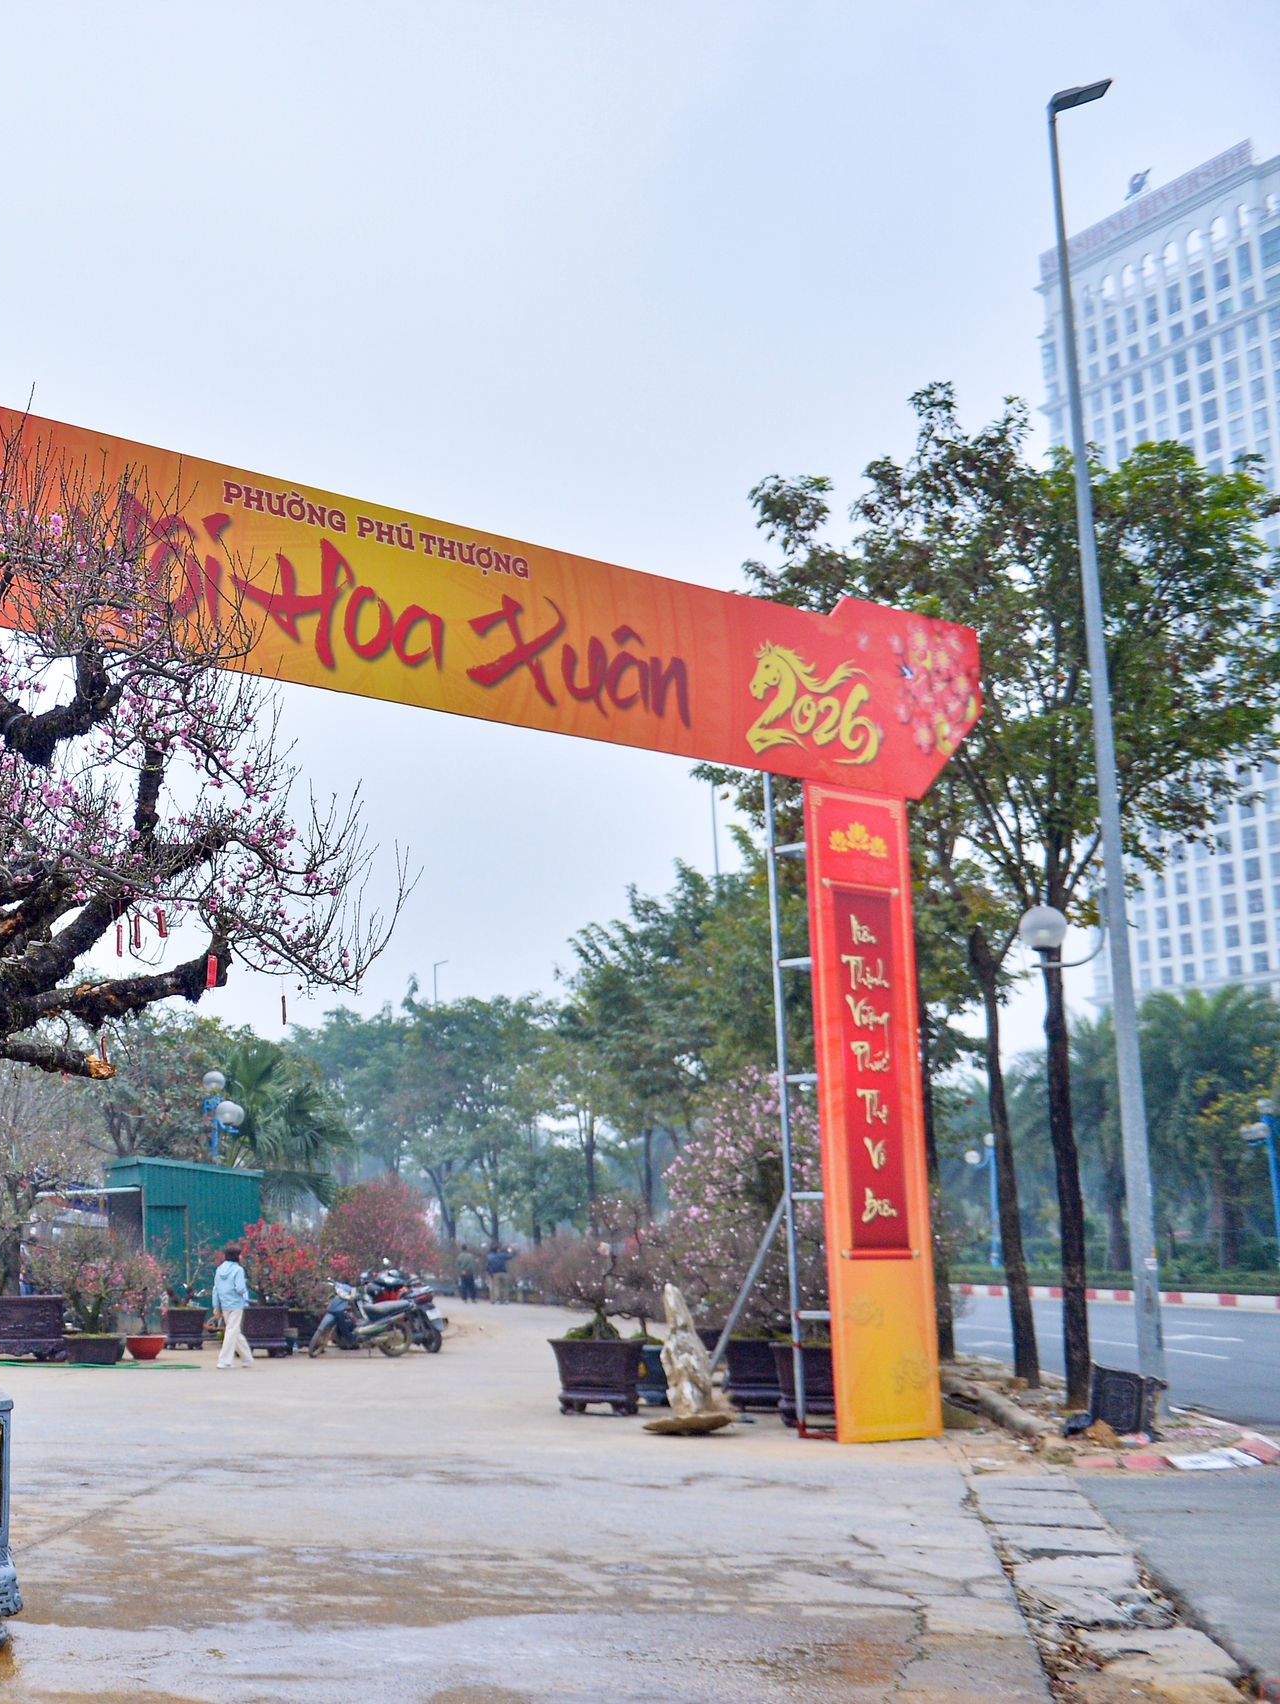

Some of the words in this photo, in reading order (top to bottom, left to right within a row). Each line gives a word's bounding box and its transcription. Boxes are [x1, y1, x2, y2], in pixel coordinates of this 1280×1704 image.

[222, 480, 347, 534] PHƯỜNG
[356, 514, 415, 551] PHÚ
[418, 531, 530, 580] THƯỢNG
[230, 538, 443, 669] Hoa
[466, 594, 691, 730] Xuân
[746, 639, 880, 765] 2026
[840, 954, 890, 991] Thịnh
[845, 994, 890, 1060] Vượng
[850, 1040, 890, 1073] Phúc
[856, 1088, 888, 1125] Thọ
[863, 1136, 887, 1171] Vô
